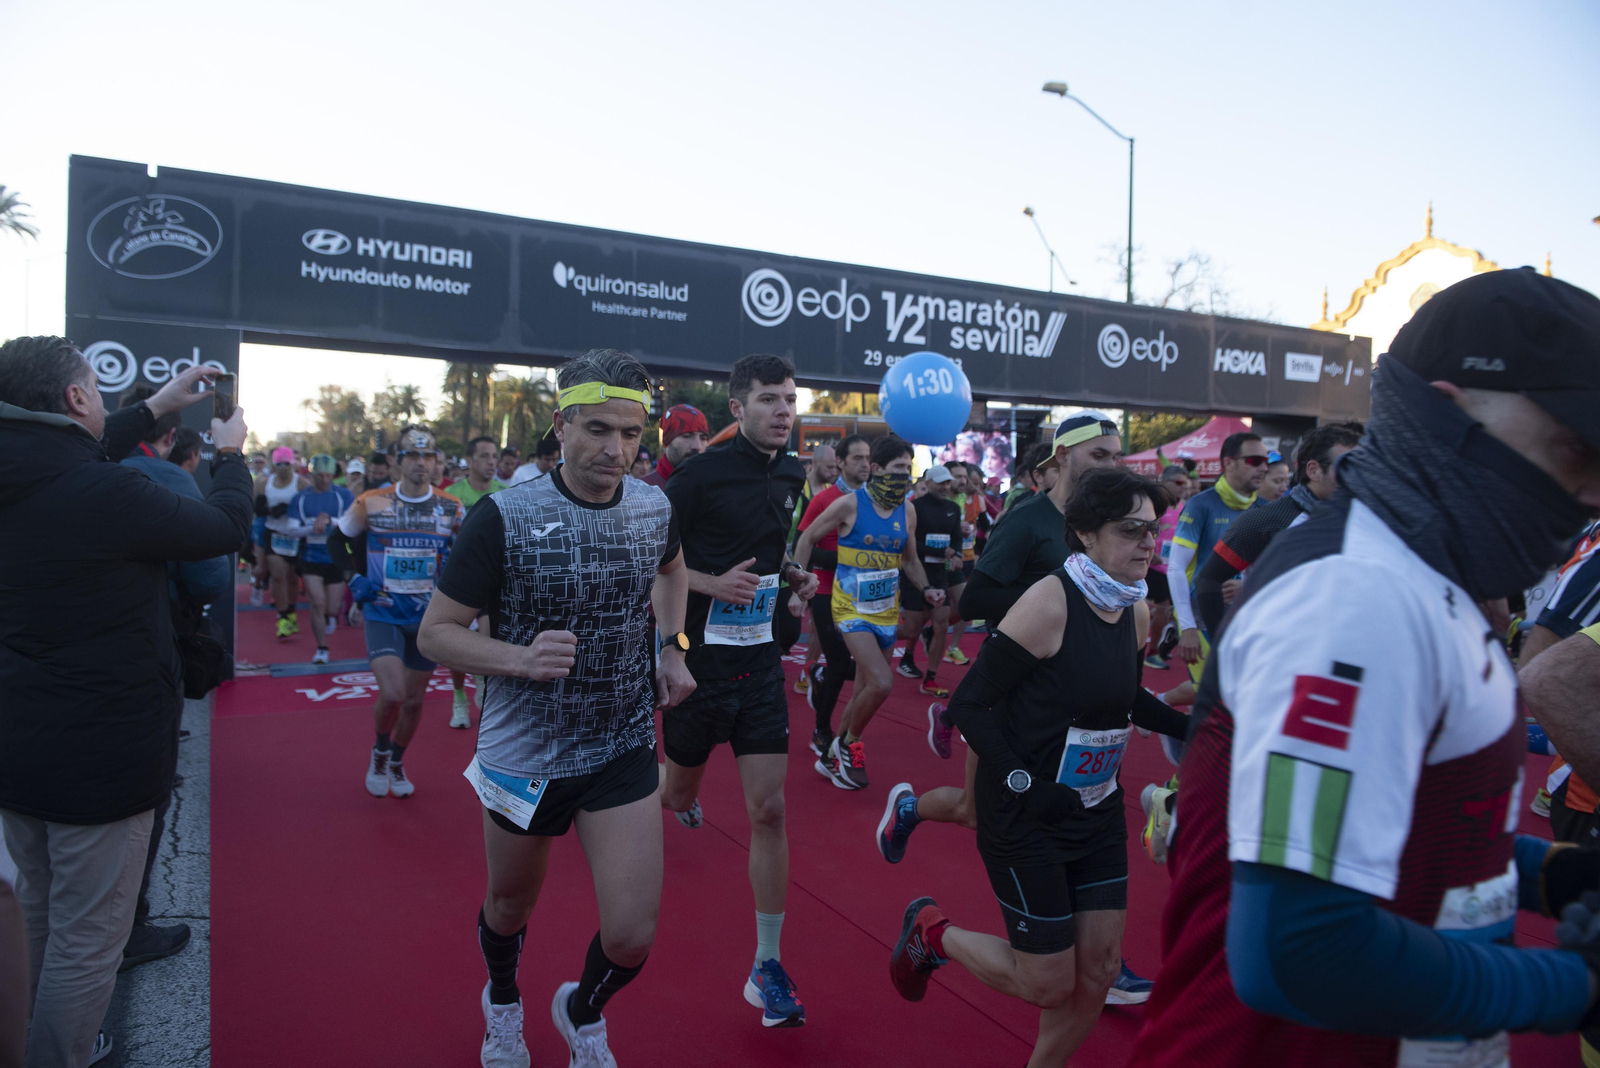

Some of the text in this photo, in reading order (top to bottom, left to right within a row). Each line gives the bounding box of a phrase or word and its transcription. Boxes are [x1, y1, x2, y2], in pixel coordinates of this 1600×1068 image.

[356, 236, 473, 269] HYUNDAI
[300, 260, 471, 296] Hyundauto Motor
[591, 300, 688, 322] Healthcare Partner
[796, 277, 871, 333] edp
[917, 294, 1040, 332] maratón
[864, 350, 882, 367] 29
[1131, 329, 1179, 372] edp
[1213, 347, 1267, 376] HOKA
[1461, 356, 1506, 371] FILA
[903, 367, 953, 399] 1:30
[394, 559, 424, 574] 1947
[868, 581, 886, 596] 951
[1092, 735, 1108, 745] edp
[488, 784, 502, 796] edp
